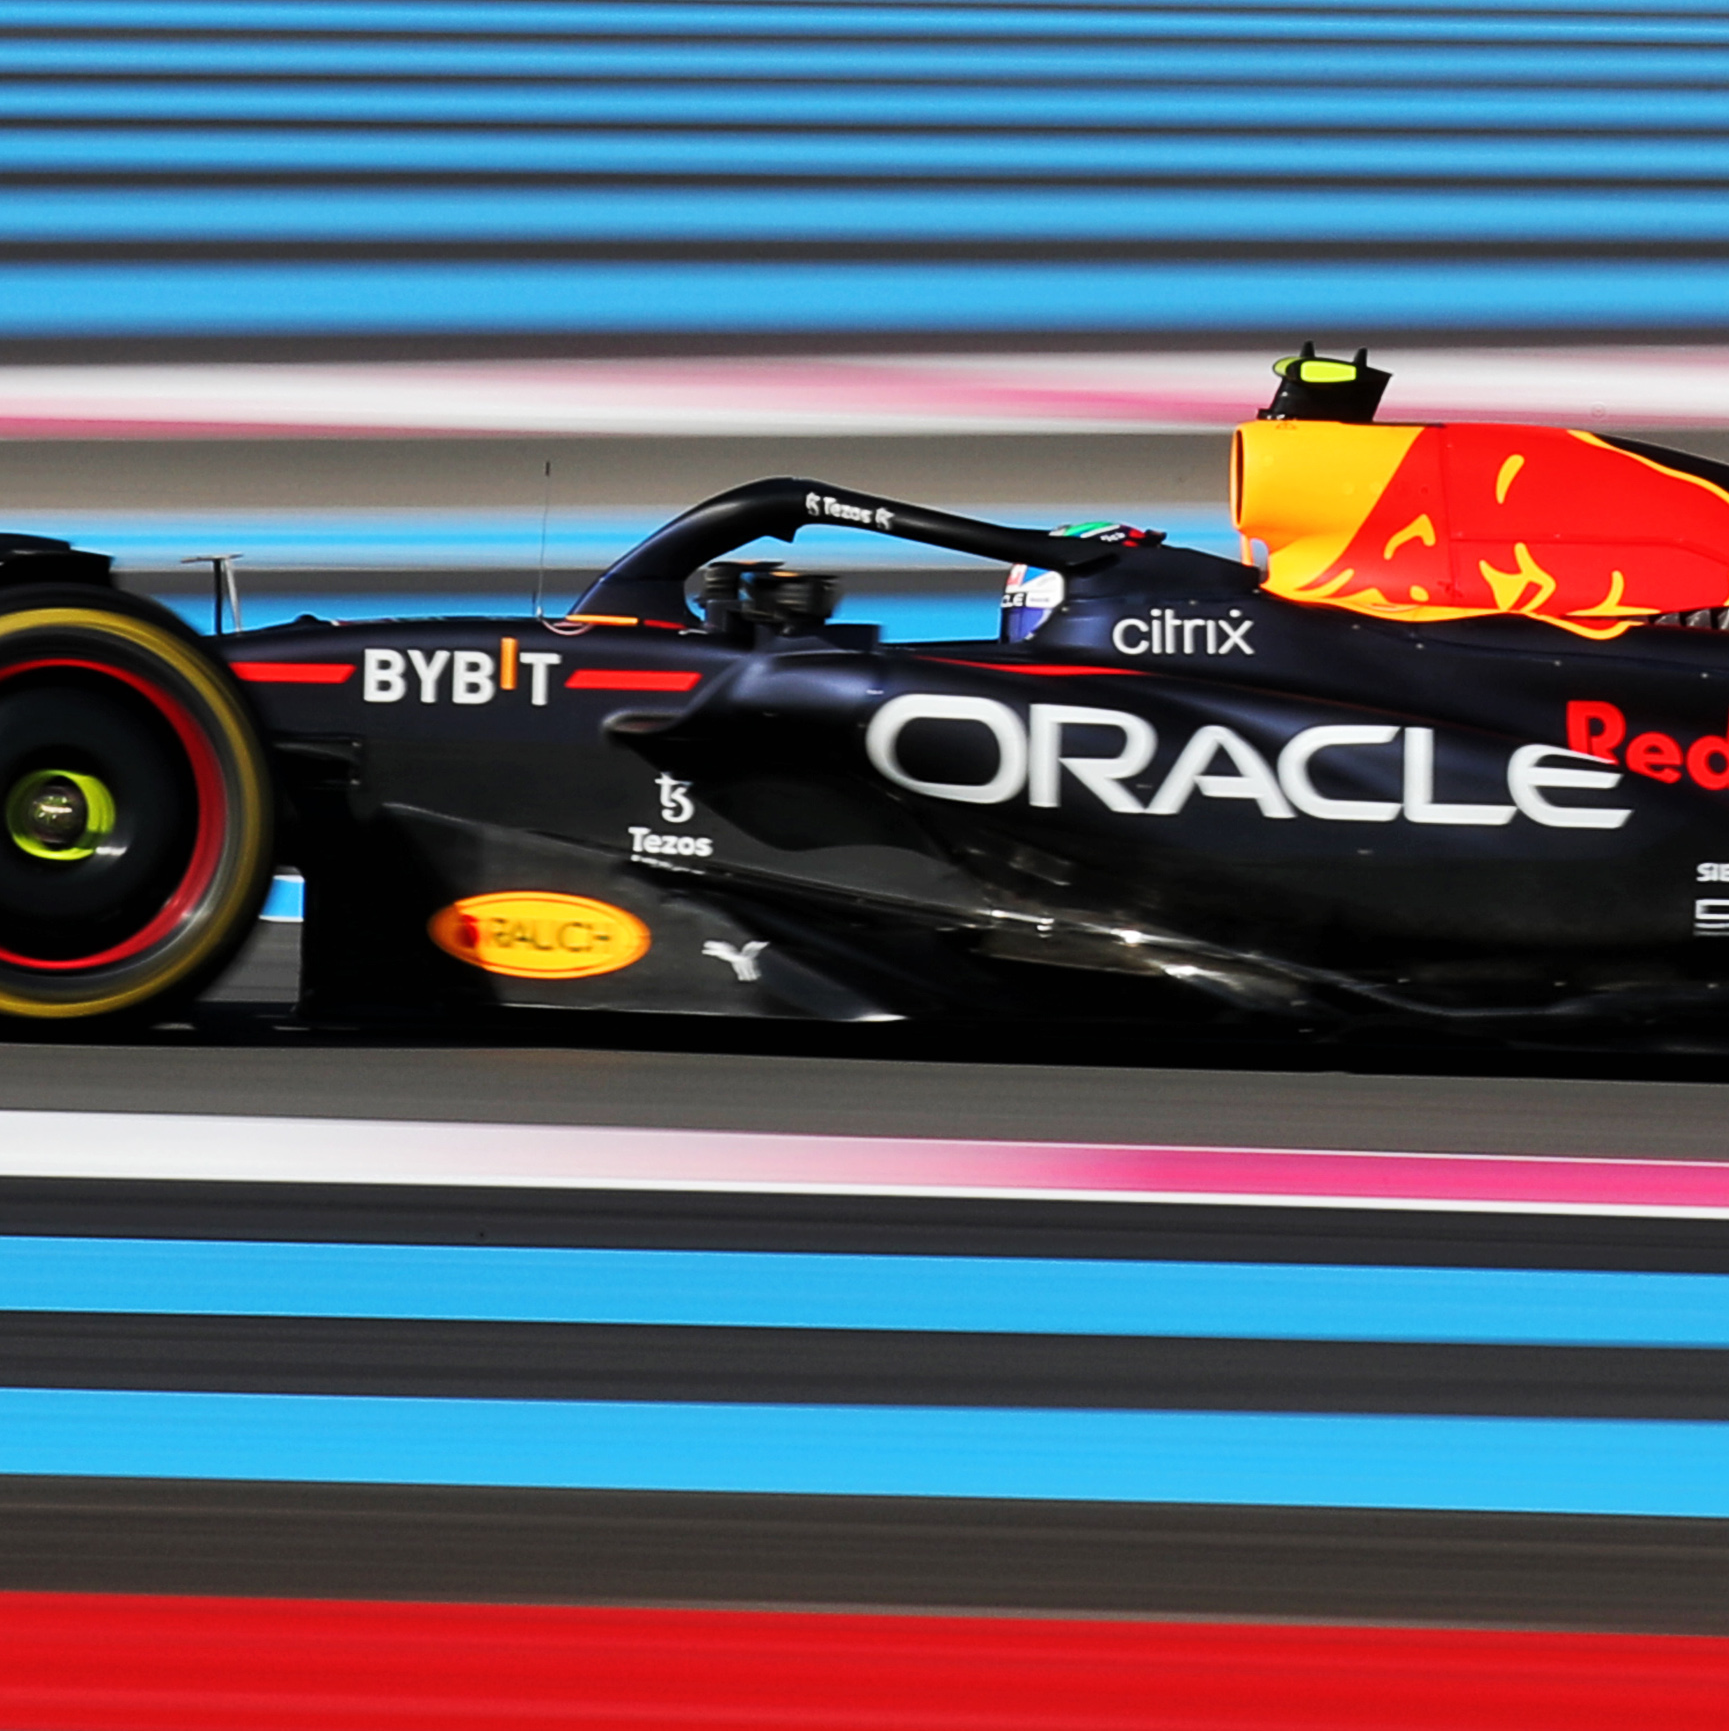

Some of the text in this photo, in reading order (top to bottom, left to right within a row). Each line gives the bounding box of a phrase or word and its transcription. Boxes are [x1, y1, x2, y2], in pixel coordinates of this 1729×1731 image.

[1112, 608, 1256, 655] citrix
[363, 637, 562, 706] BYBIT
[866, 693, 1634, 829] ORACLE
[628, 826, 714, 857] Tezos
